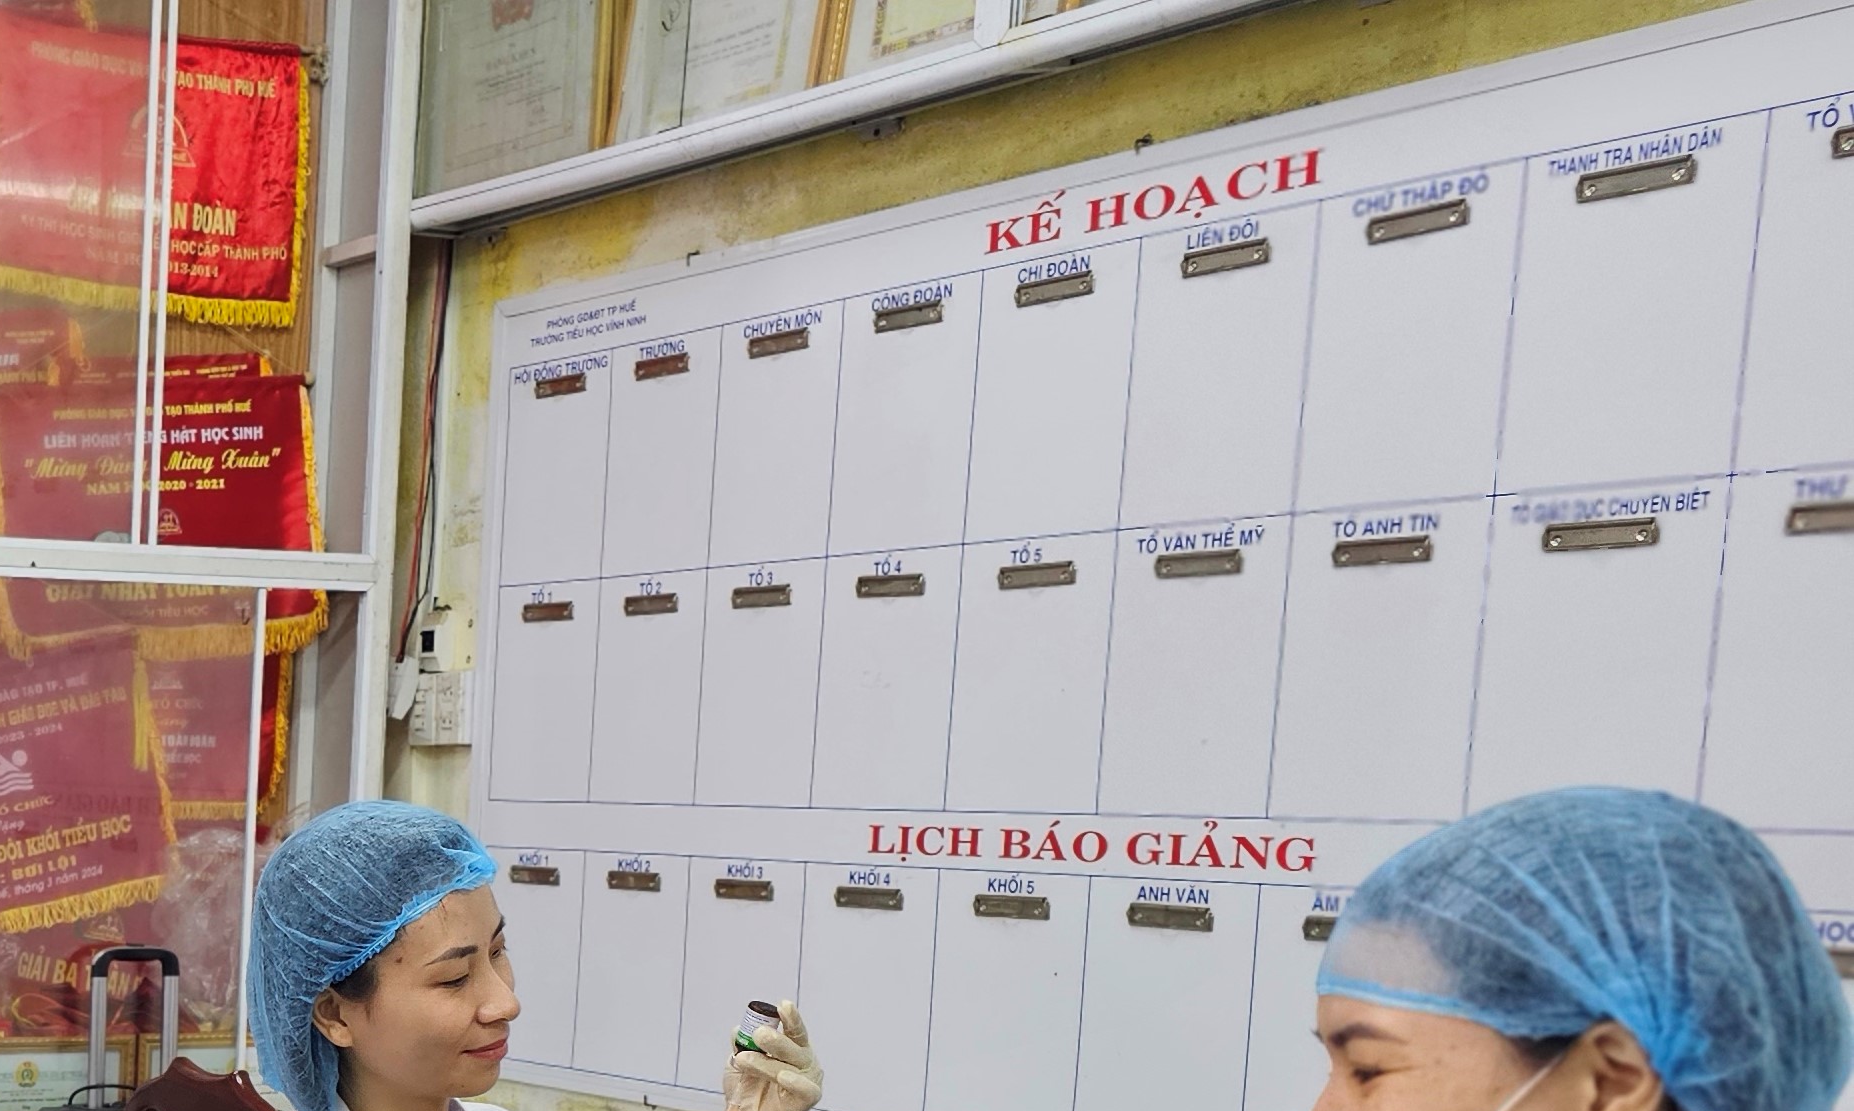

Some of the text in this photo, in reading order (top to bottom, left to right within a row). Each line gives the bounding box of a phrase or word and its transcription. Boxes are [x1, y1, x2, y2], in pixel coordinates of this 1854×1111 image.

[1548, 126, 1723, 177] THANH TRA NHÂN DÂN
[985, 148, 1325, 256] KẾ HOẠCH
[1352, 188, 1395, 217] CHỮ
[1401, 178, 1453, 209] THẬP
[193, 200, 237, 236] ĐOÀN
[1187, 220, 1259, 250] LIÊN ĐỘI
[1018, 253, 1091, 283] CHI ĐOÀN
[871, 282, 953, 312] CÔNG ĐOÀN
[743, 310, 823, 339] CHUYÊN MÔN
[514, 371, 532, 385] HỘI
[165, 399, 252, 417] TẠO THÀNH PHỐ HUẾ
[170, 425, 198, 443] HÁT
[200, 426, 230, 446] HỌC
[231, 426, 263, 440] SINH
[164, 449, 215, 473] Mừng
[196, 478, 225, 490] 2021
[1609, 494, 1672, 517] CHUYÊN
[1673, 488, 1711, 513] BIỆT
[1162, 528, 1201, 551] VĂN
[1203, 520, 1237, 551] THỂ
[1237, 525, 1267, 546] MỸ
[1361, 516, 1406, 536] ANH
[1408, 512, 1439, 532] TIN
[1010, 540, 1042, 564] TỔ 5
[25, 831, 60, 857] KHỐI
[61, 817, 97, 849] TIỂU
[101, 814, 133, 841] HỌC
[867, 818, 1317, 873] LỊCH BÁO GIẢNG
[987, 872, 1035, 895] KHỐI 5
[1137, 884, 1210, 905] ANH VĂN
